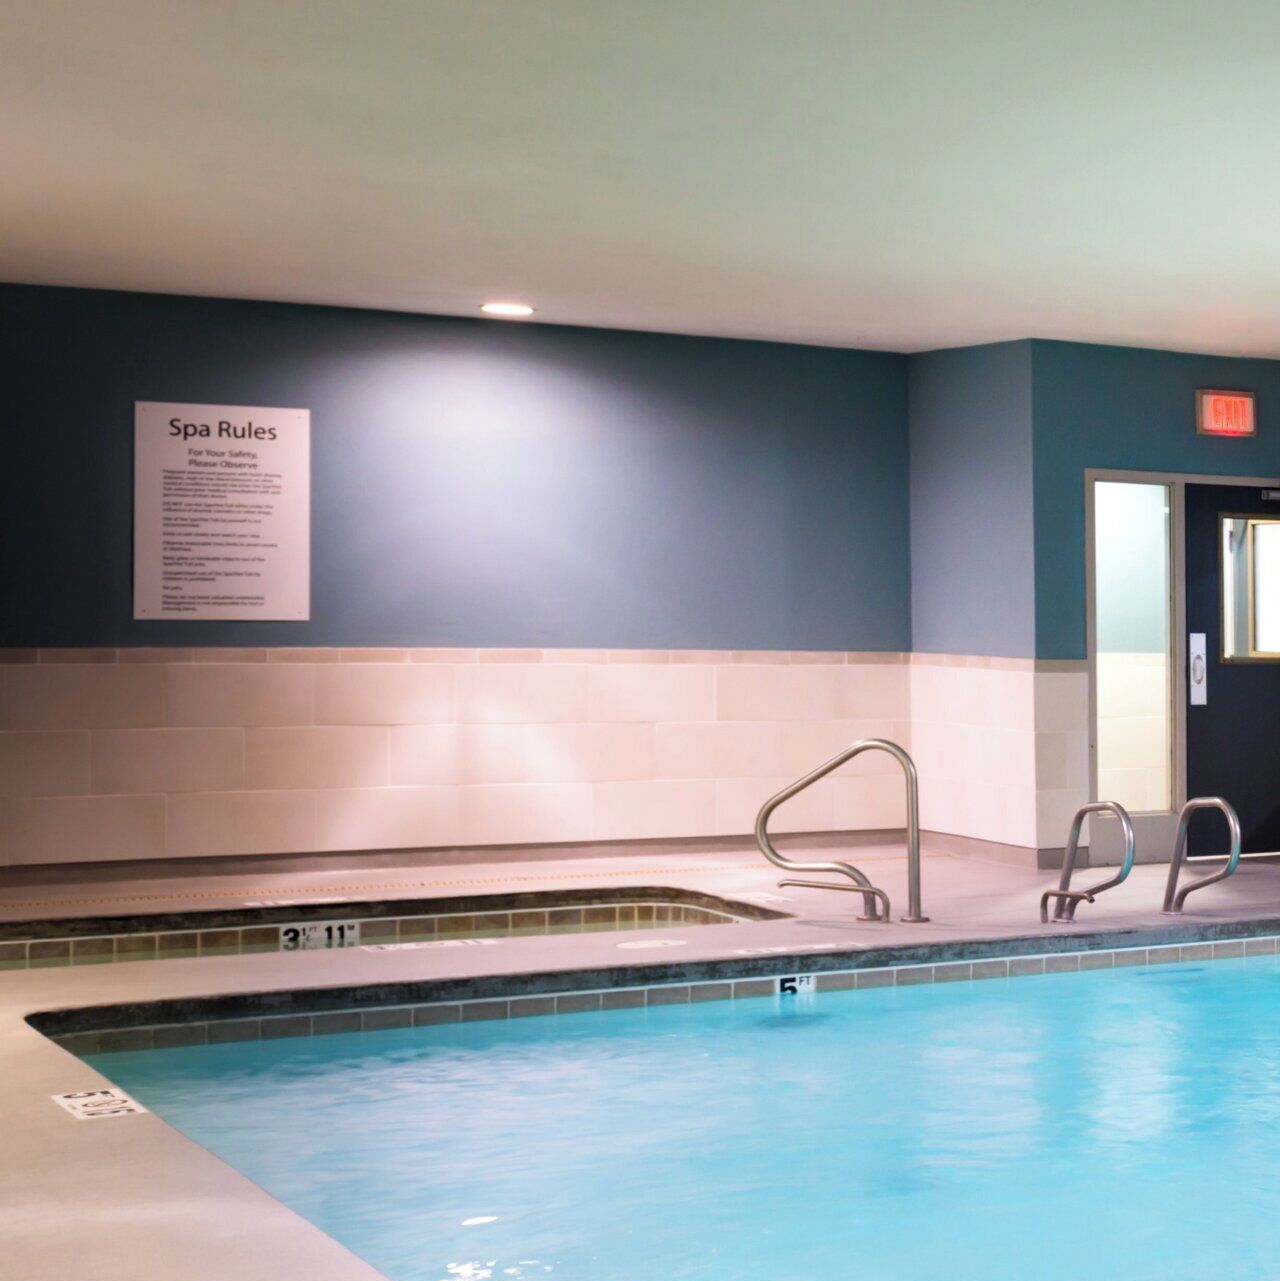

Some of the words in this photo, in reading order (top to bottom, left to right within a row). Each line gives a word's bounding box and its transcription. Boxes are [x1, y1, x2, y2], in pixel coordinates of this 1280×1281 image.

[169, 418, 210, 441] Spa
[218, 420, 277, 440] Rules
[188, 448, 203, 456] For
[205, 449, 226, 457] Your
[188, 459, 217, 467] Please
[220, 460, 257, 468] Observe
[780, 977, 797, 996] 5
[799, 976, 811, 986] FT
